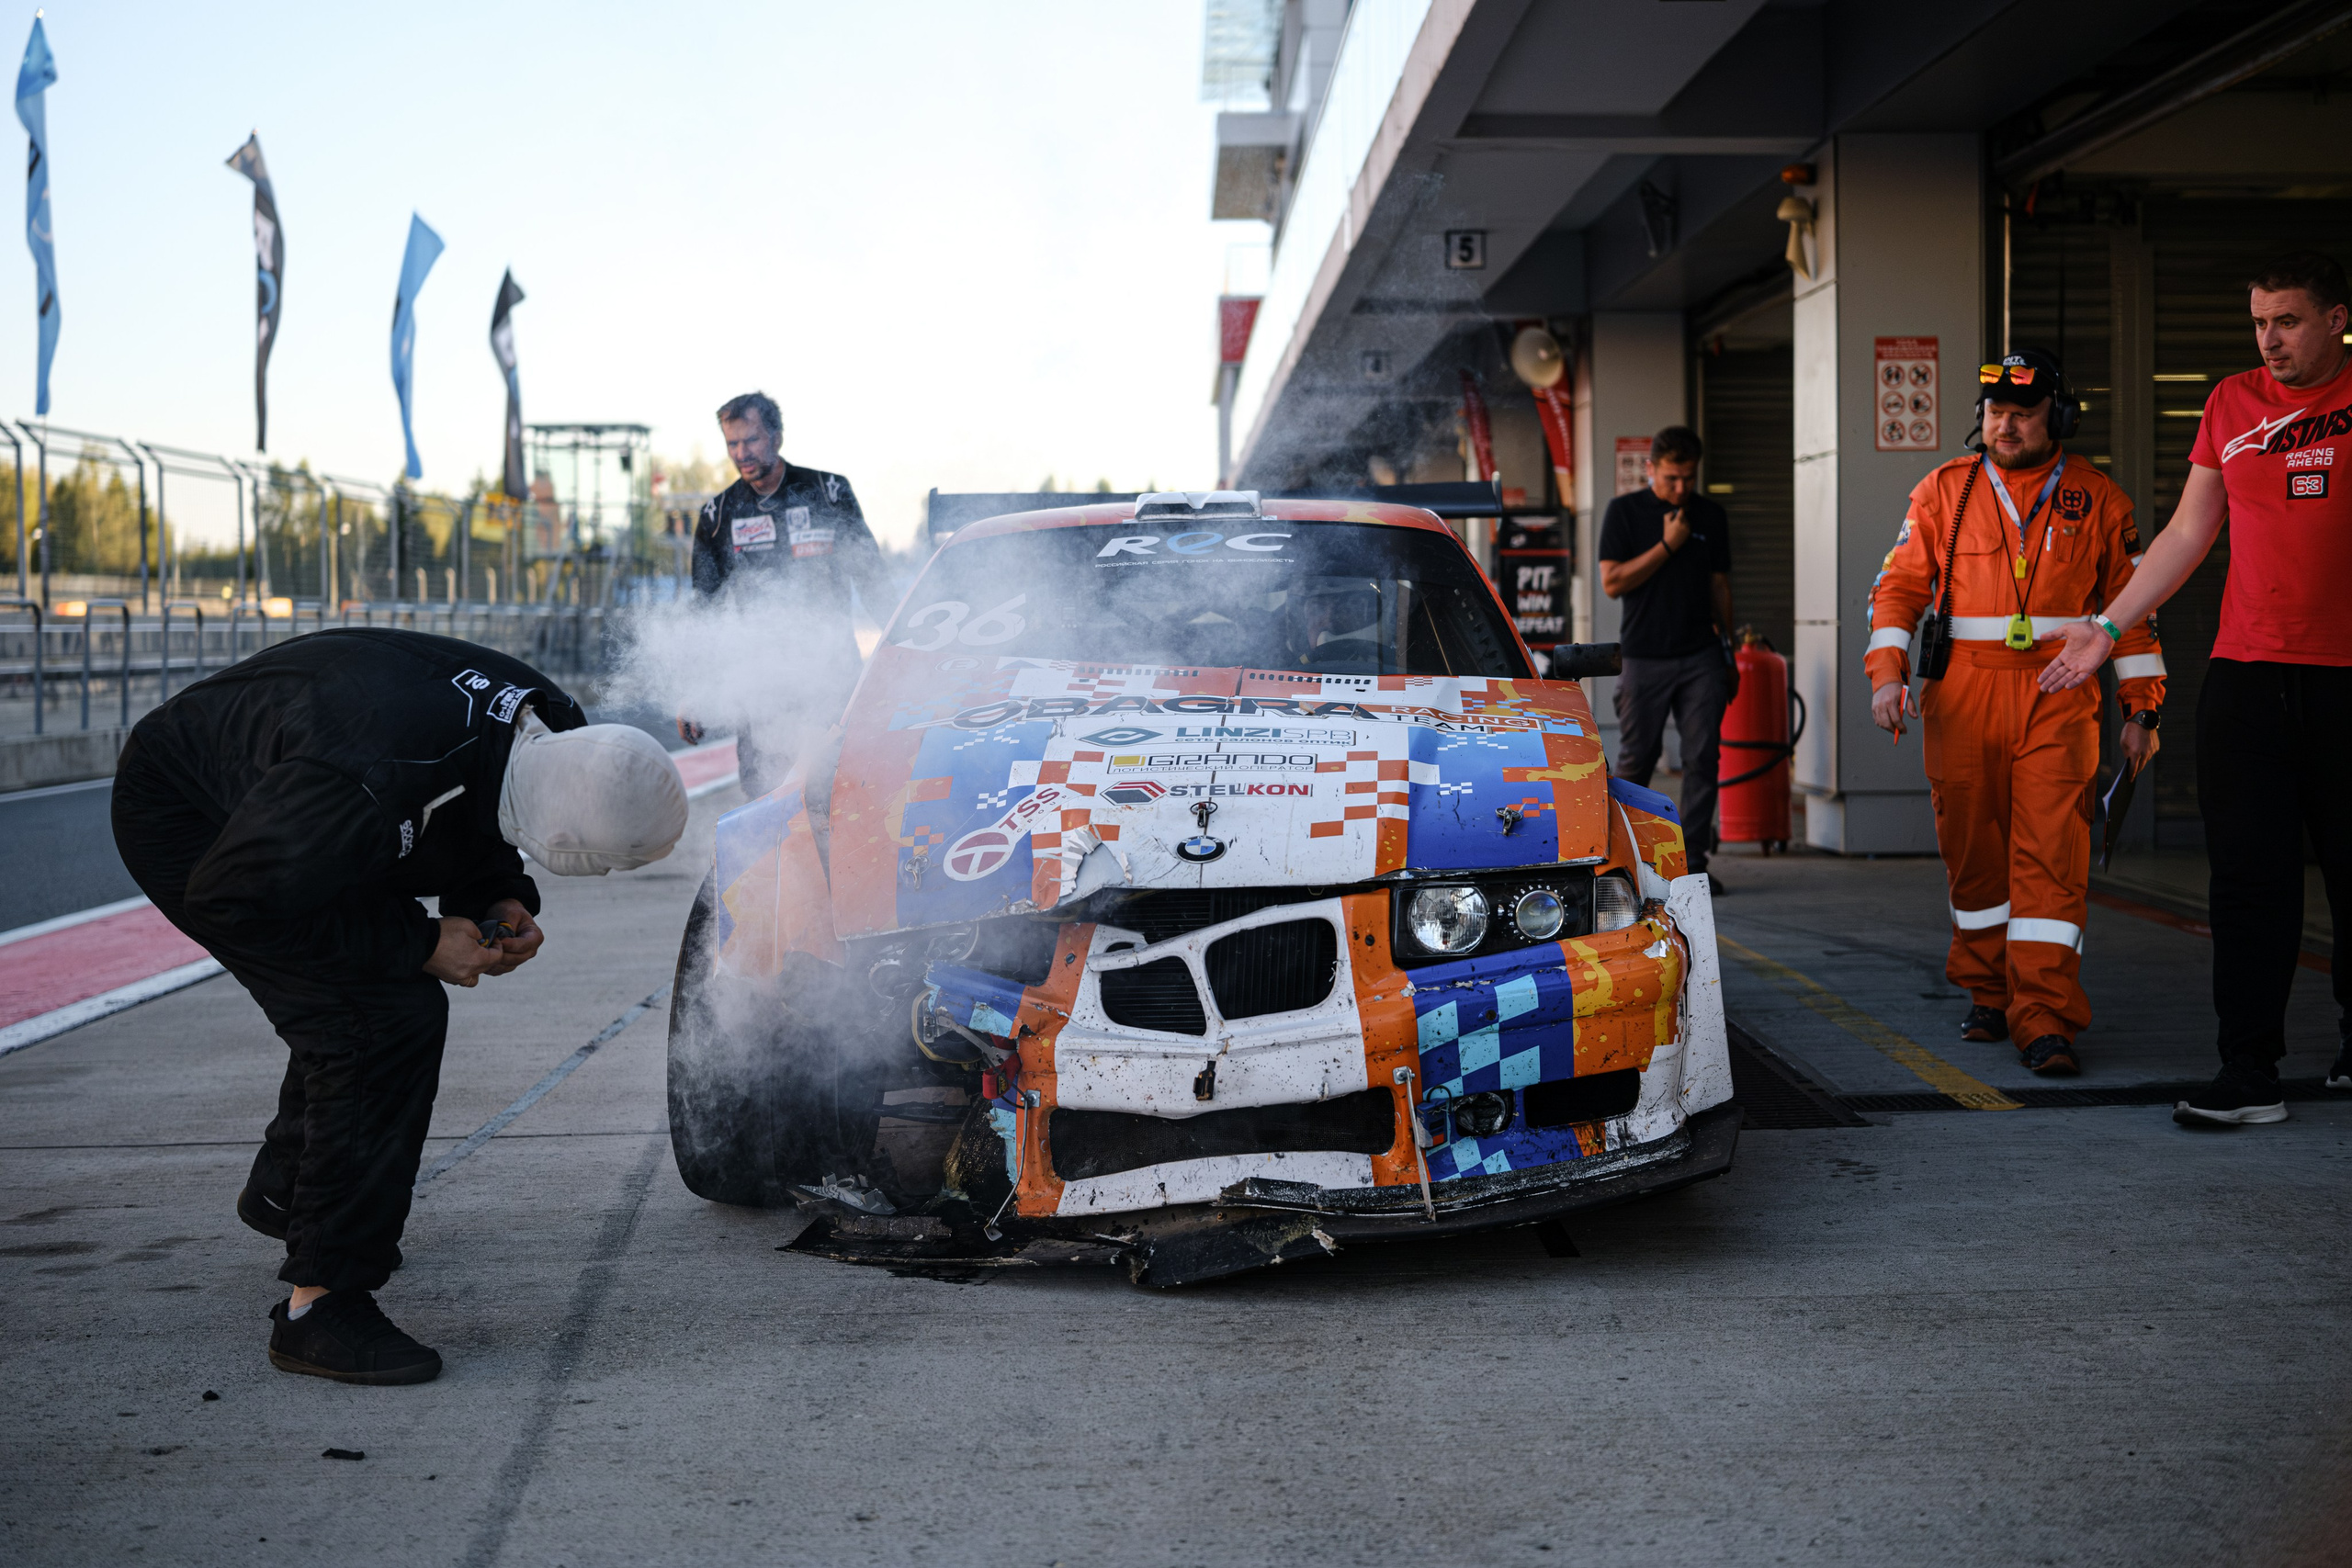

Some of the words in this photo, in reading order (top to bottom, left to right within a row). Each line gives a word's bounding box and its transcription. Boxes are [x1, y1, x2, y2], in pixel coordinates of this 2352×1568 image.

[1459, 236, 1474, 262] 5
[2285, 447, 2335, 459] RACING
[2287, 457, 2334, 468] AHEAD
[2292, 475, 2324, 496] 63
[1095, 560, 1148, 569] РОССИЙСКАЯ
[1517, 566, 1555, 591] PIT
[1517, 594, 1552, 612] WIN
[895, 592, 1026, 652] 36
[953, 695, 1380, 728] OBAGRA
[1391, 705, 1531, 727] RACING
[1389, 714, 1485, 732] TEAM
[1112, 764, 1233, 773] ЛОГИСТИЧЕСКИЙ
[1148, 754, 1314, 766] GRANDO
[1170, 784, 1308, 796] STELKON
[998, 788, 1060, 831] TSS
